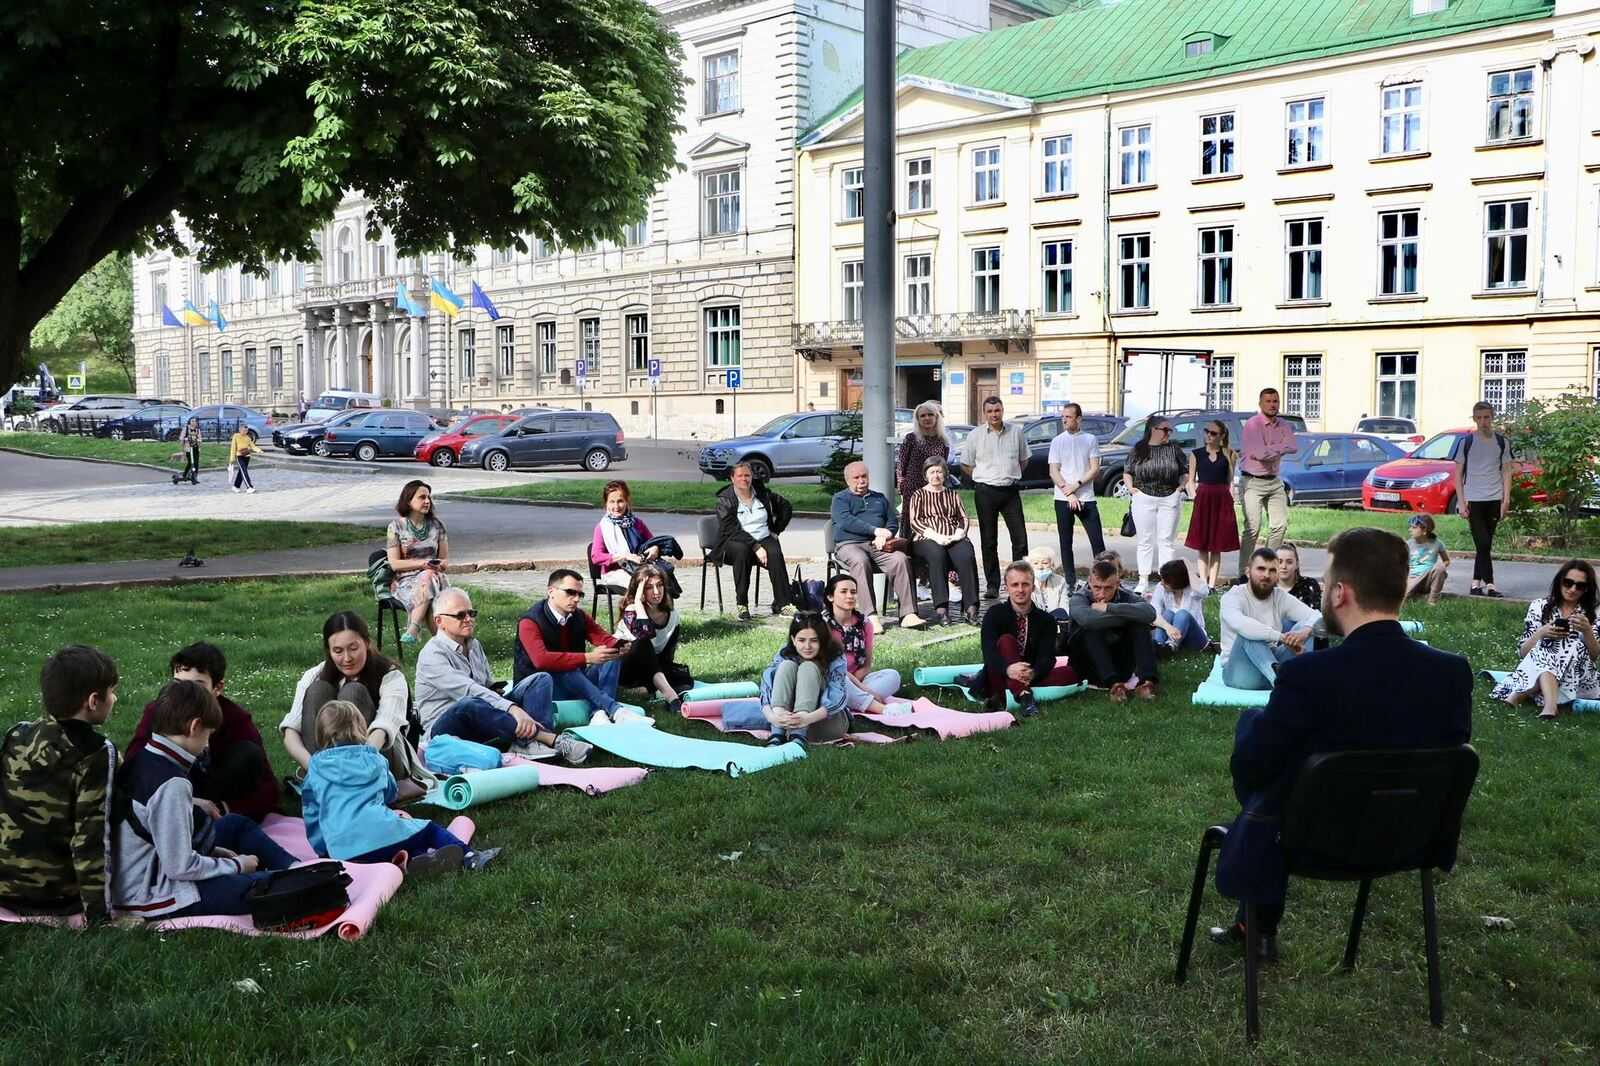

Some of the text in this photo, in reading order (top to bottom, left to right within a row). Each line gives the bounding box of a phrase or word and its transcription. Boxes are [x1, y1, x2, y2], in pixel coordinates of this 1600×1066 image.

[578, 362, 584, 374] P
[650, 361, 658, 375] P
[730, 371, 738, 388] P
